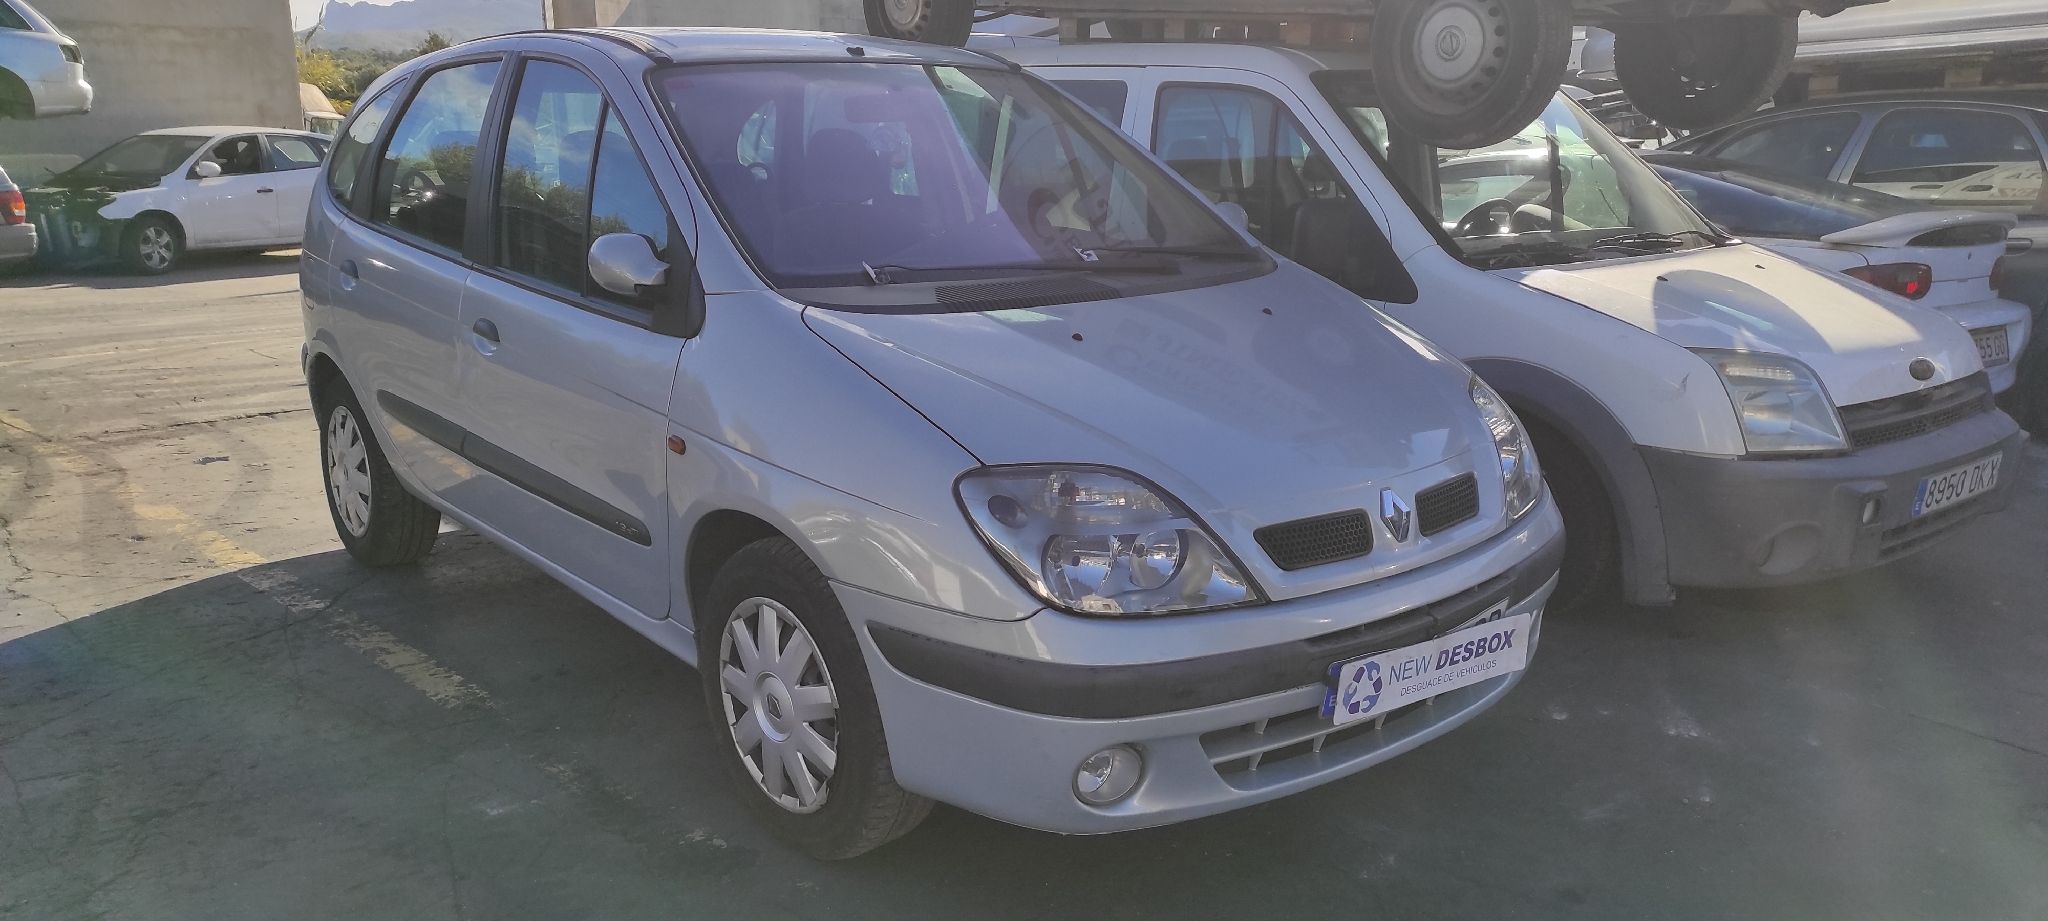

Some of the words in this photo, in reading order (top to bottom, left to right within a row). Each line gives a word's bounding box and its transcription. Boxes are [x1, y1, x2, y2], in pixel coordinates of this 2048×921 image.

[1925, 470, 1967, 508] 8950
[1969, 457, 1999, 493] DKX
[1389, 654, 1432, 685] NEW
[1435, 628, 1516, 670] DESBOX
[1400, 675, 1442, 696] DESGUACE
[1443, 671, 1455, 683] DE
